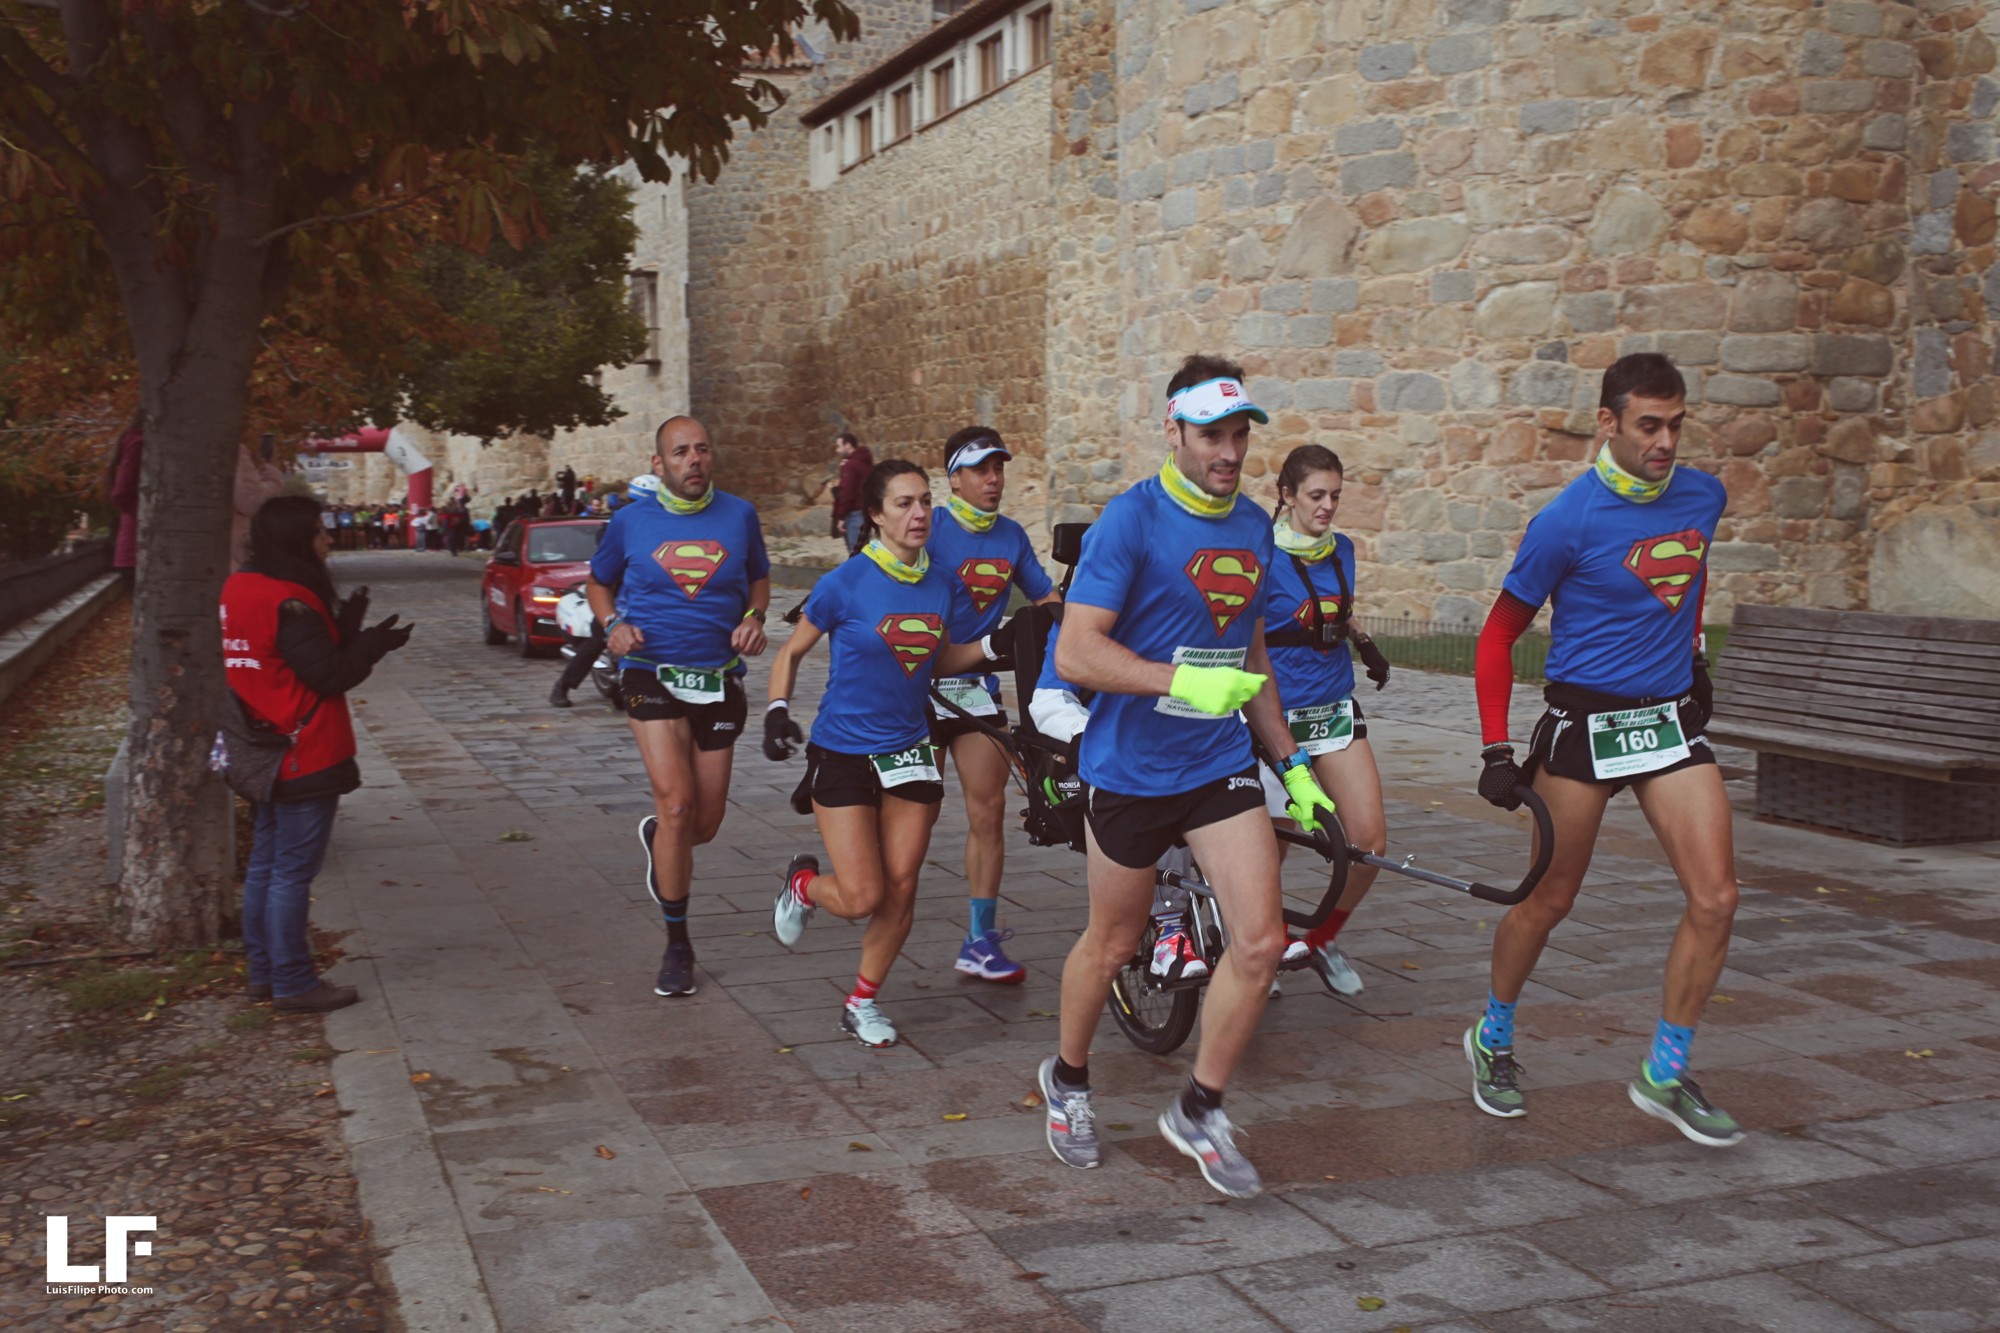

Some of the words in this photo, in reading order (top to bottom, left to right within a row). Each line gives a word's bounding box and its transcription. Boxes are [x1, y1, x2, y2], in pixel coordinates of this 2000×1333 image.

[675, 673, 706, 689] 161
[1308, 722, 1329, 739] 25
[1615, 728, 1659, 753] 160
[890, 748, 923, 766] 342
